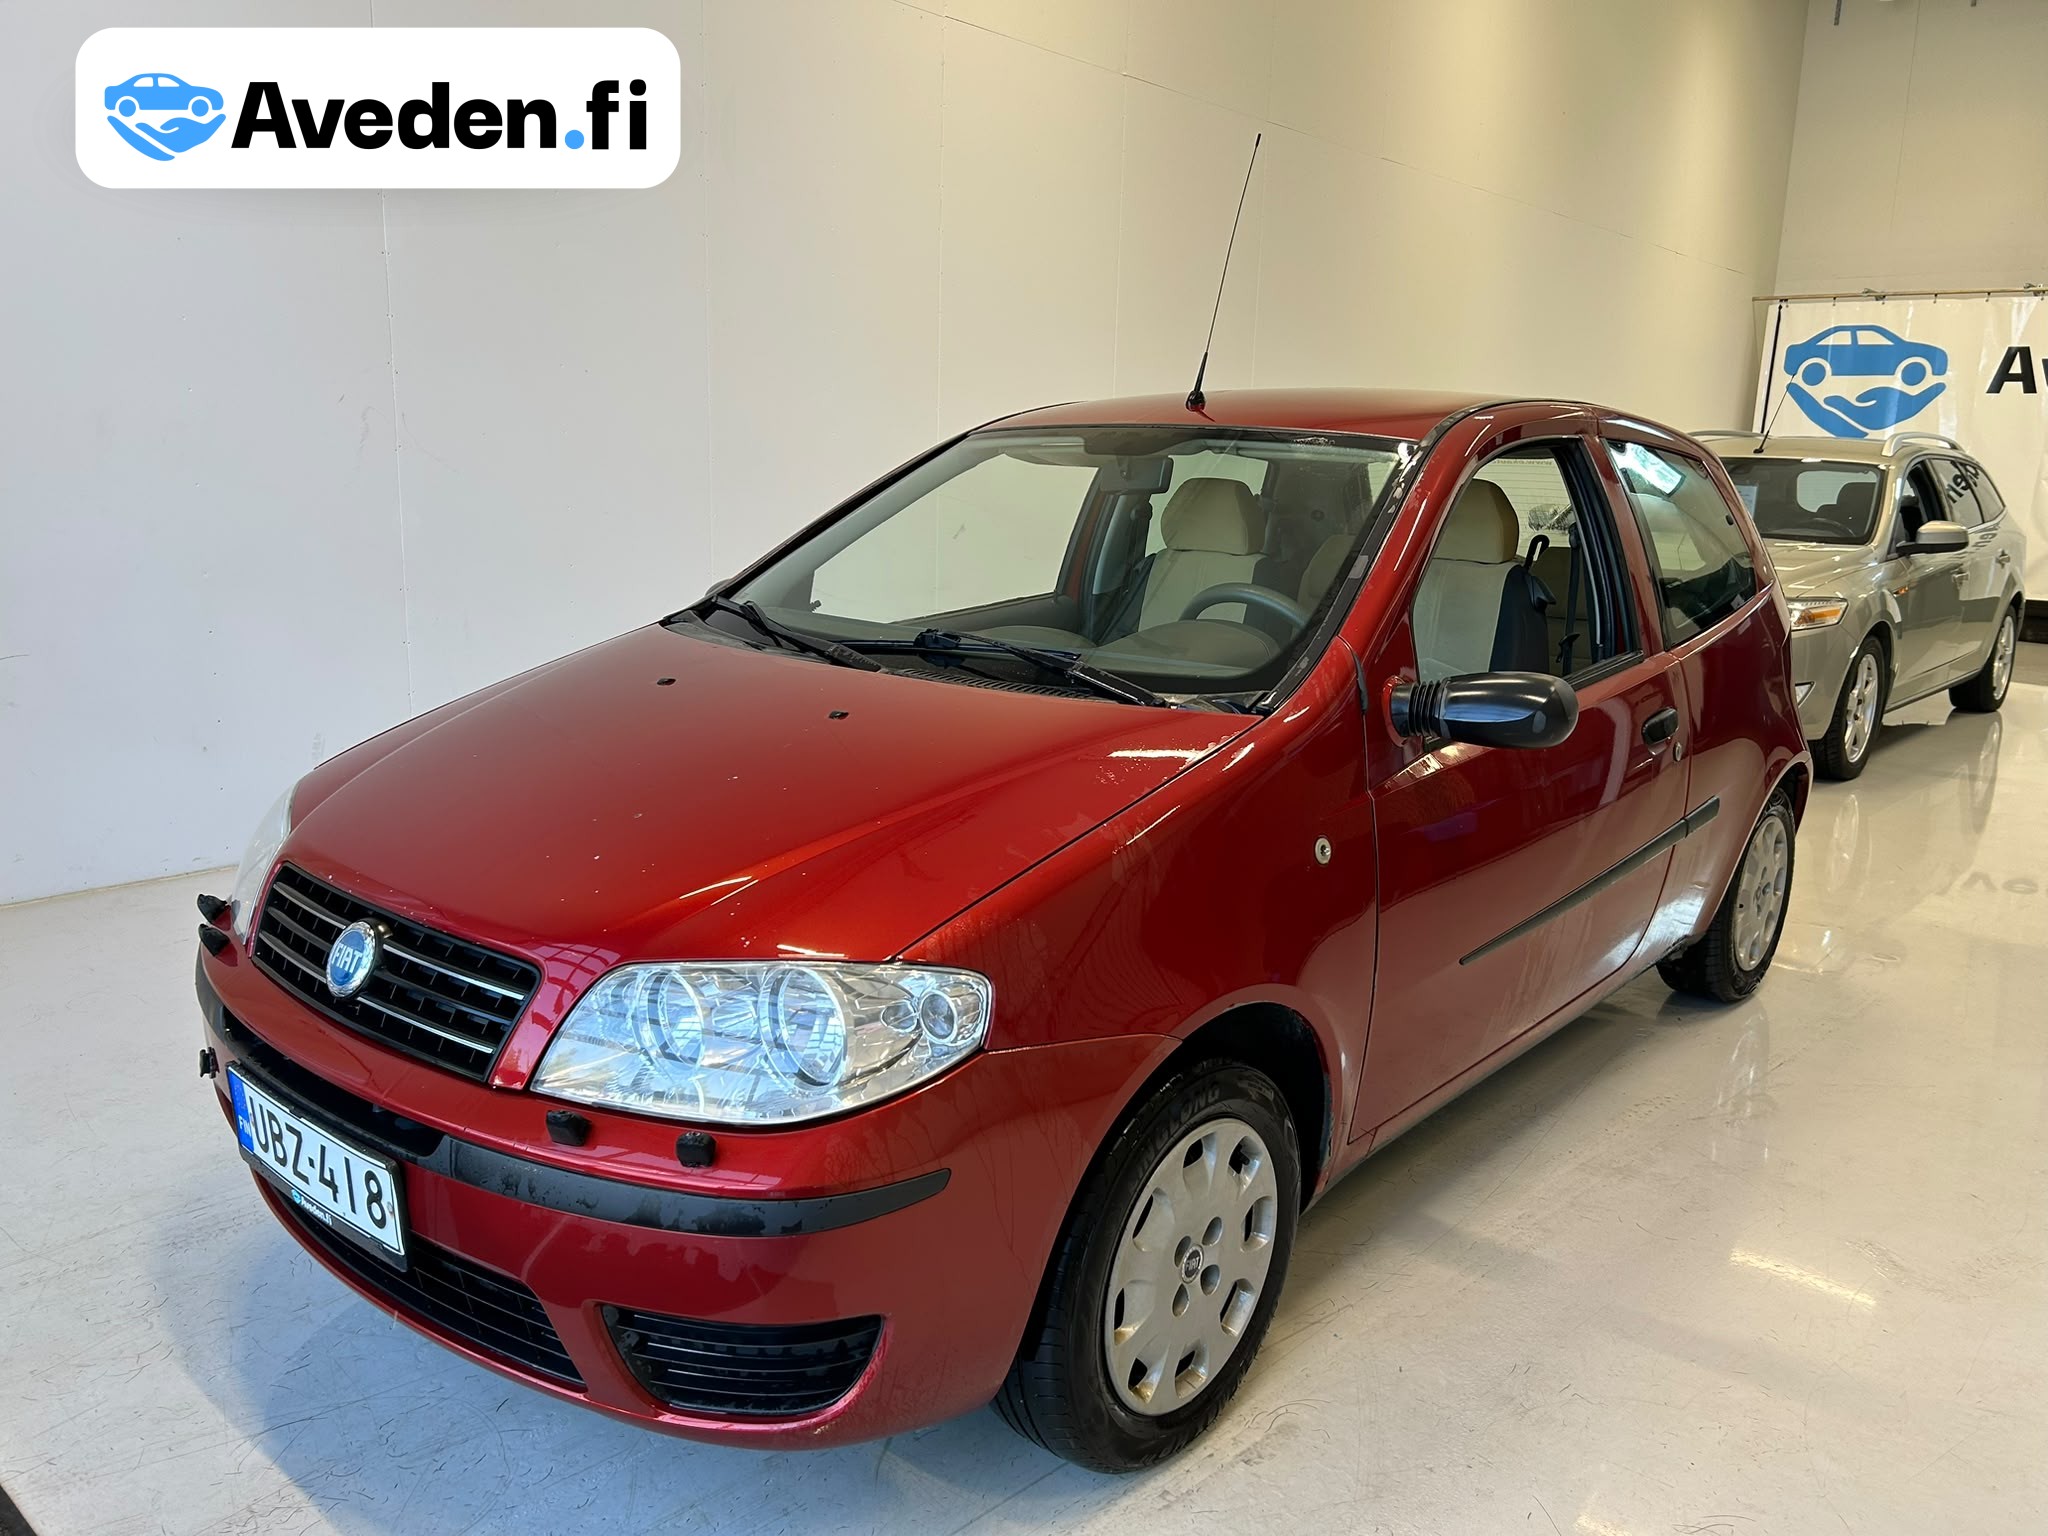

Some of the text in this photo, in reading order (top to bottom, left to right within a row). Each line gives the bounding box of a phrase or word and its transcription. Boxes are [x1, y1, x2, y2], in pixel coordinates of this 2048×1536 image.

[1986, 346, 2048, 393] A
[331, 942, 363, 974] FIAT
[238, 1115, 252, 1137] FIN
[249, 1095, 387, 1229] UBZ-418
